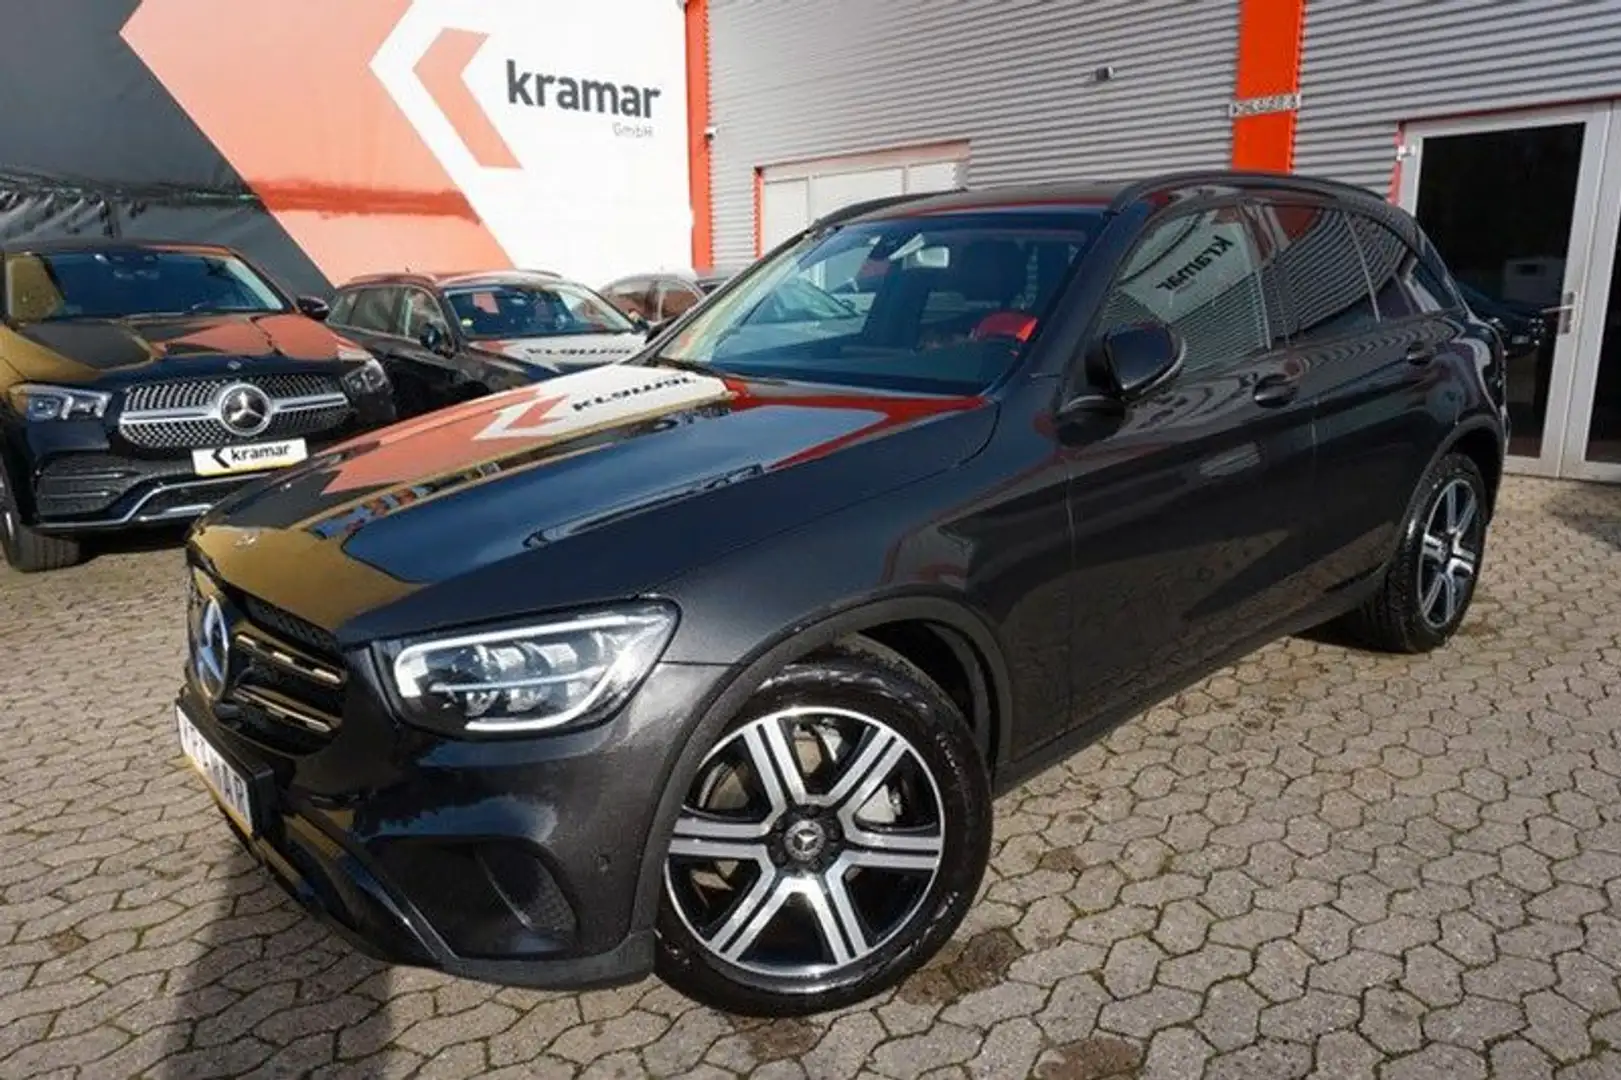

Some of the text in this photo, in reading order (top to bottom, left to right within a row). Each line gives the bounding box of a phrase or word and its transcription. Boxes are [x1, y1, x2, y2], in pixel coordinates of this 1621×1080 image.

[506, 59, 661, 118] kramar
[612, 121, 653, 138] GmbH
[230, 443, 291, 462] kramar
